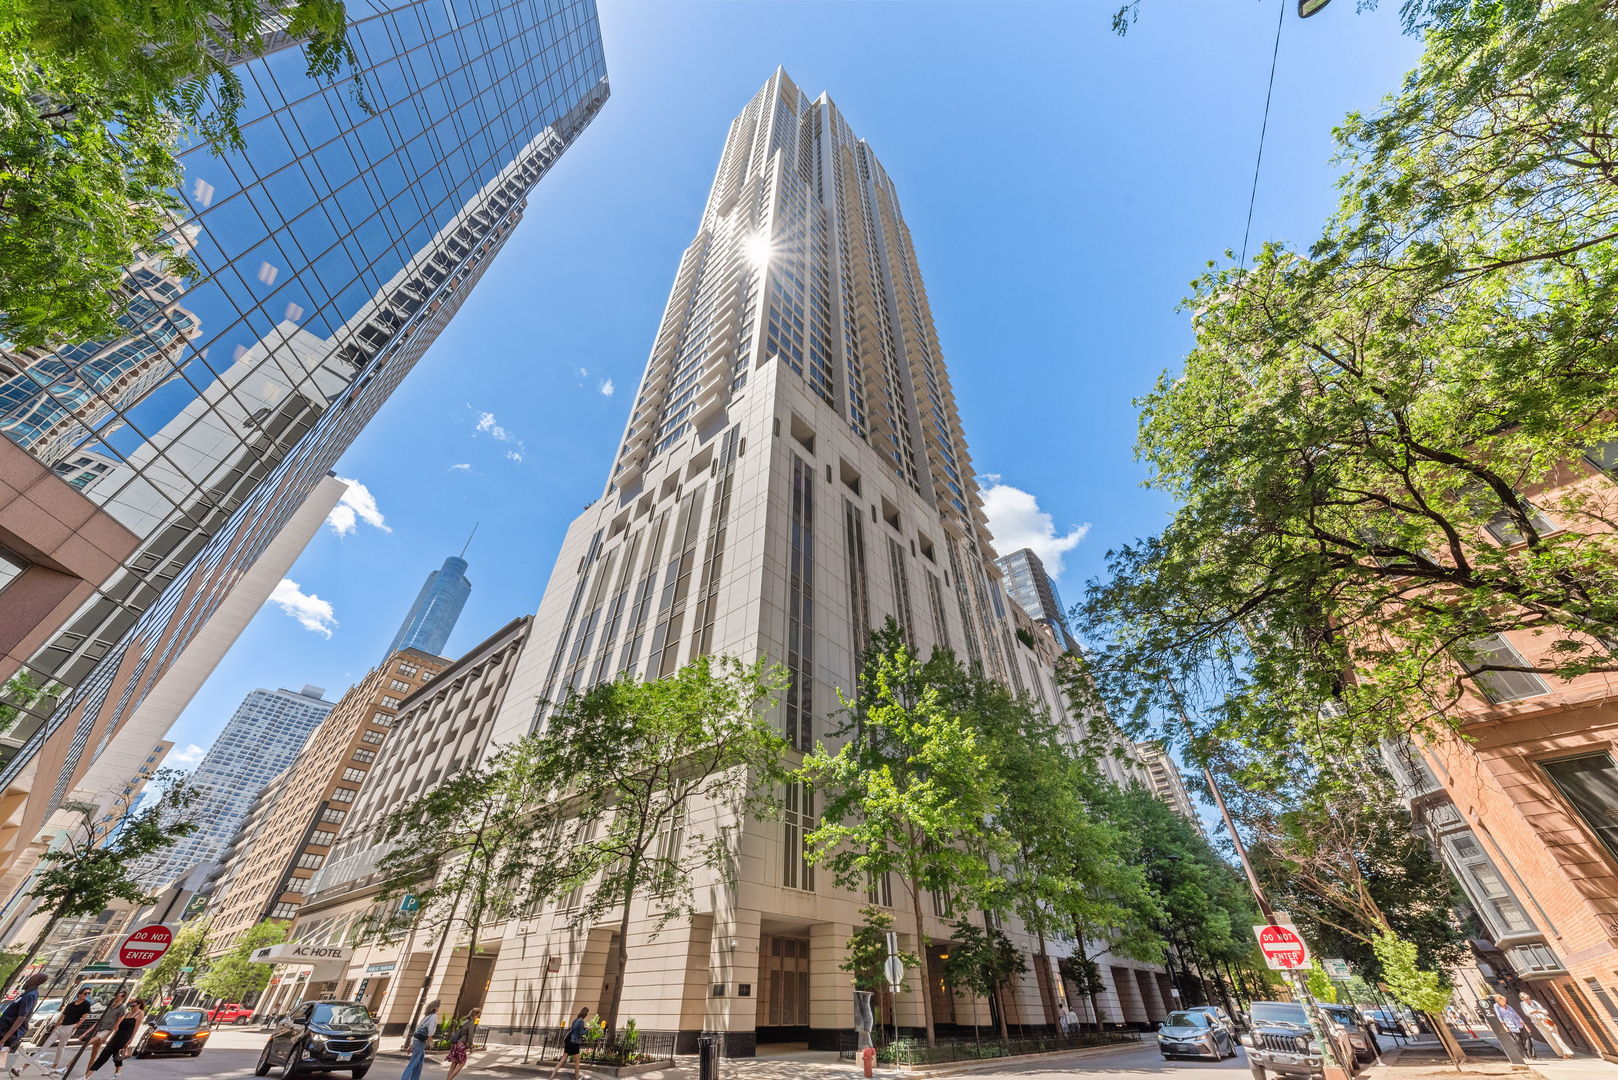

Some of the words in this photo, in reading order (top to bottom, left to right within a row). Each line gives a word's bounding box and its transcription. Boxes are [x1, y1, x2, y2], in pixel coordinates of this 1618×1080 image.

[407, 898, 416, 907] P
[125, 951, 154, 960] ENTER
[293, 947, 310, 955] AC
[311, 949, 342, 957] HOTEL
